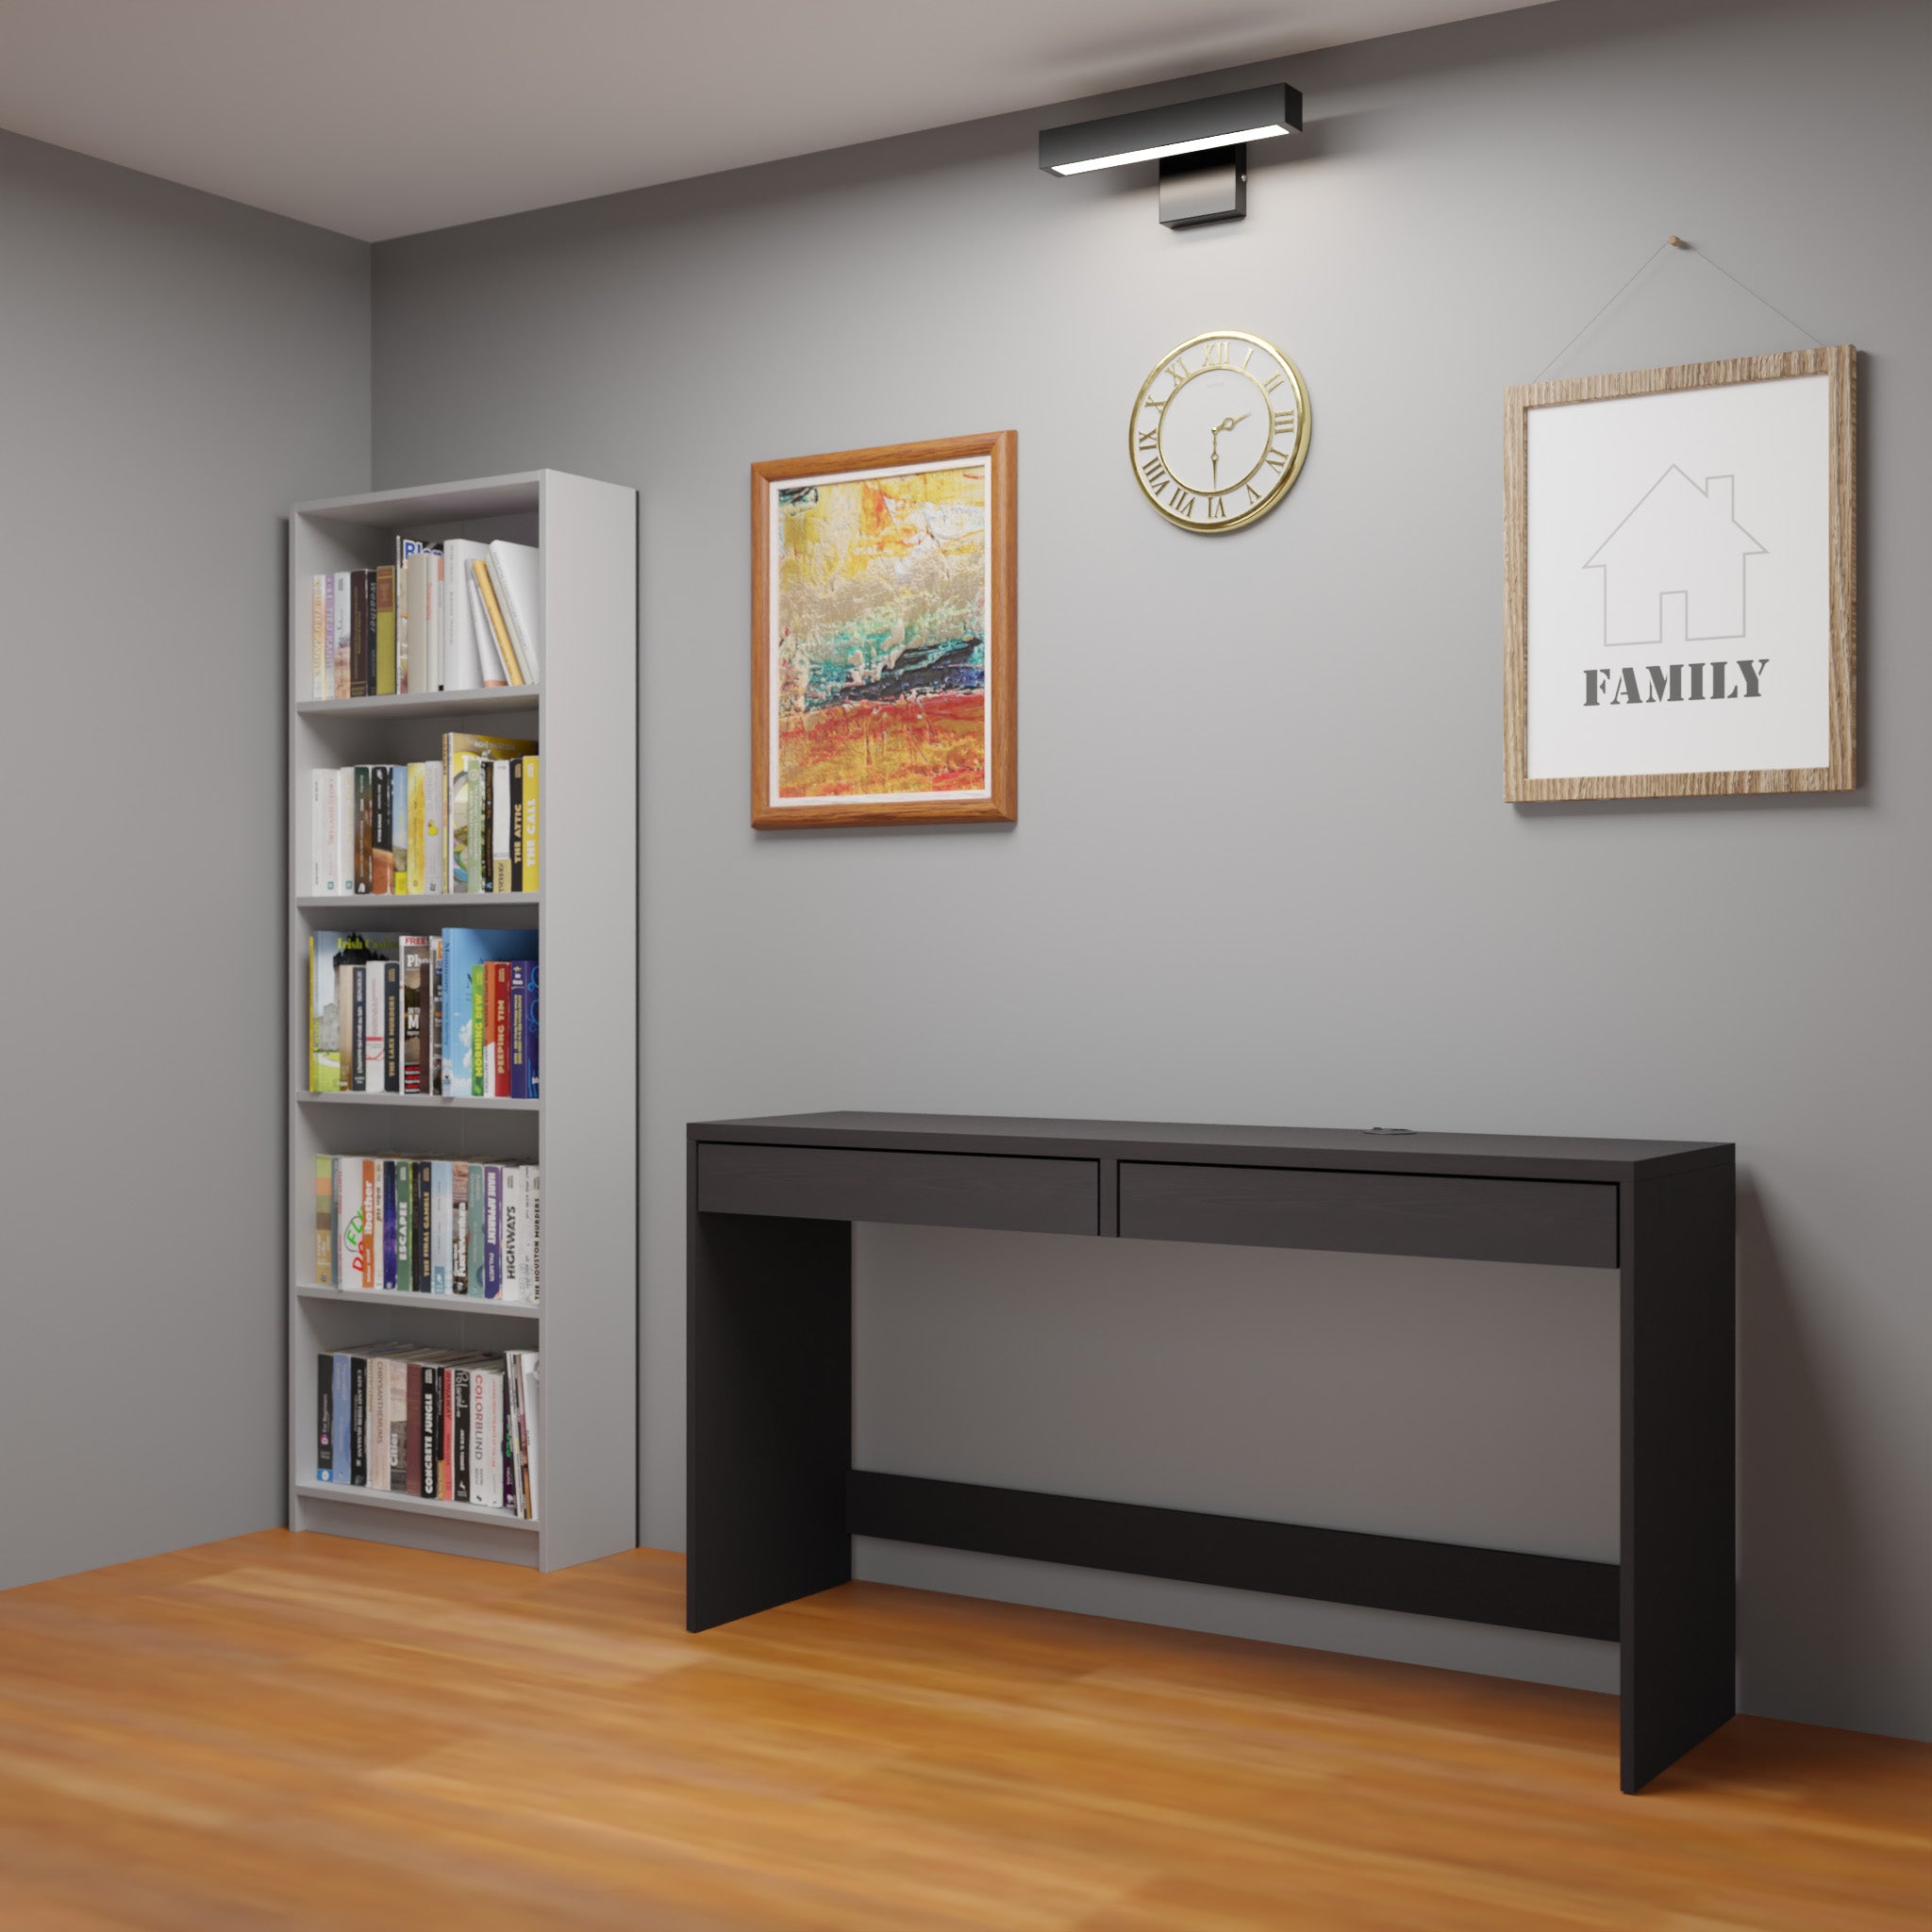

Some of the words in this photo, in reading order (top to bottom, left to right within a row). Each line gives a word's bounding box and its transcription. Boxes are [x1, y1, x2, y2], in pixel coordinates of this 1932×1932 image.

[1201, 341, 1230, 367] XII
[1242, 346, 1255, 370] I
[1165, 357, 1192, 388] XI
[1262, 370, 1285, 393] II
[1144, 396, 1167, 413] X
[1274, 409, 1294, 435] III
[1139, 428, 1157, 451] IX
[1266, 447, 1290, 475] IV
[1142, 457, 1170, 496] VIII
[1169, 488, 1195, 518] VII
[1208, 496, 1227, 519] VI
[1245, 482, 1262, 505] V
[1583, 658, 1770, 706] FAMILY
[526, 799, 536, 835] CALL
[526, 839, 536, 867] THE
[337, 937, 365, 950] Irish
[475, 994, 483, 1019] DEW
[475, 1023, 483, 1077] MORNING
[487, 1198, 496, 1245] APPARENT
[507, 1206, 516, 1279] HIGHWAYS
[425, 1393, 433, 1433] JUNGLE
[475, 1374, 483, 1461] COLORBLIND
[390, 1433, 398, 1466] Cities
[425, 1439, 433, 1493] CONCRETE
